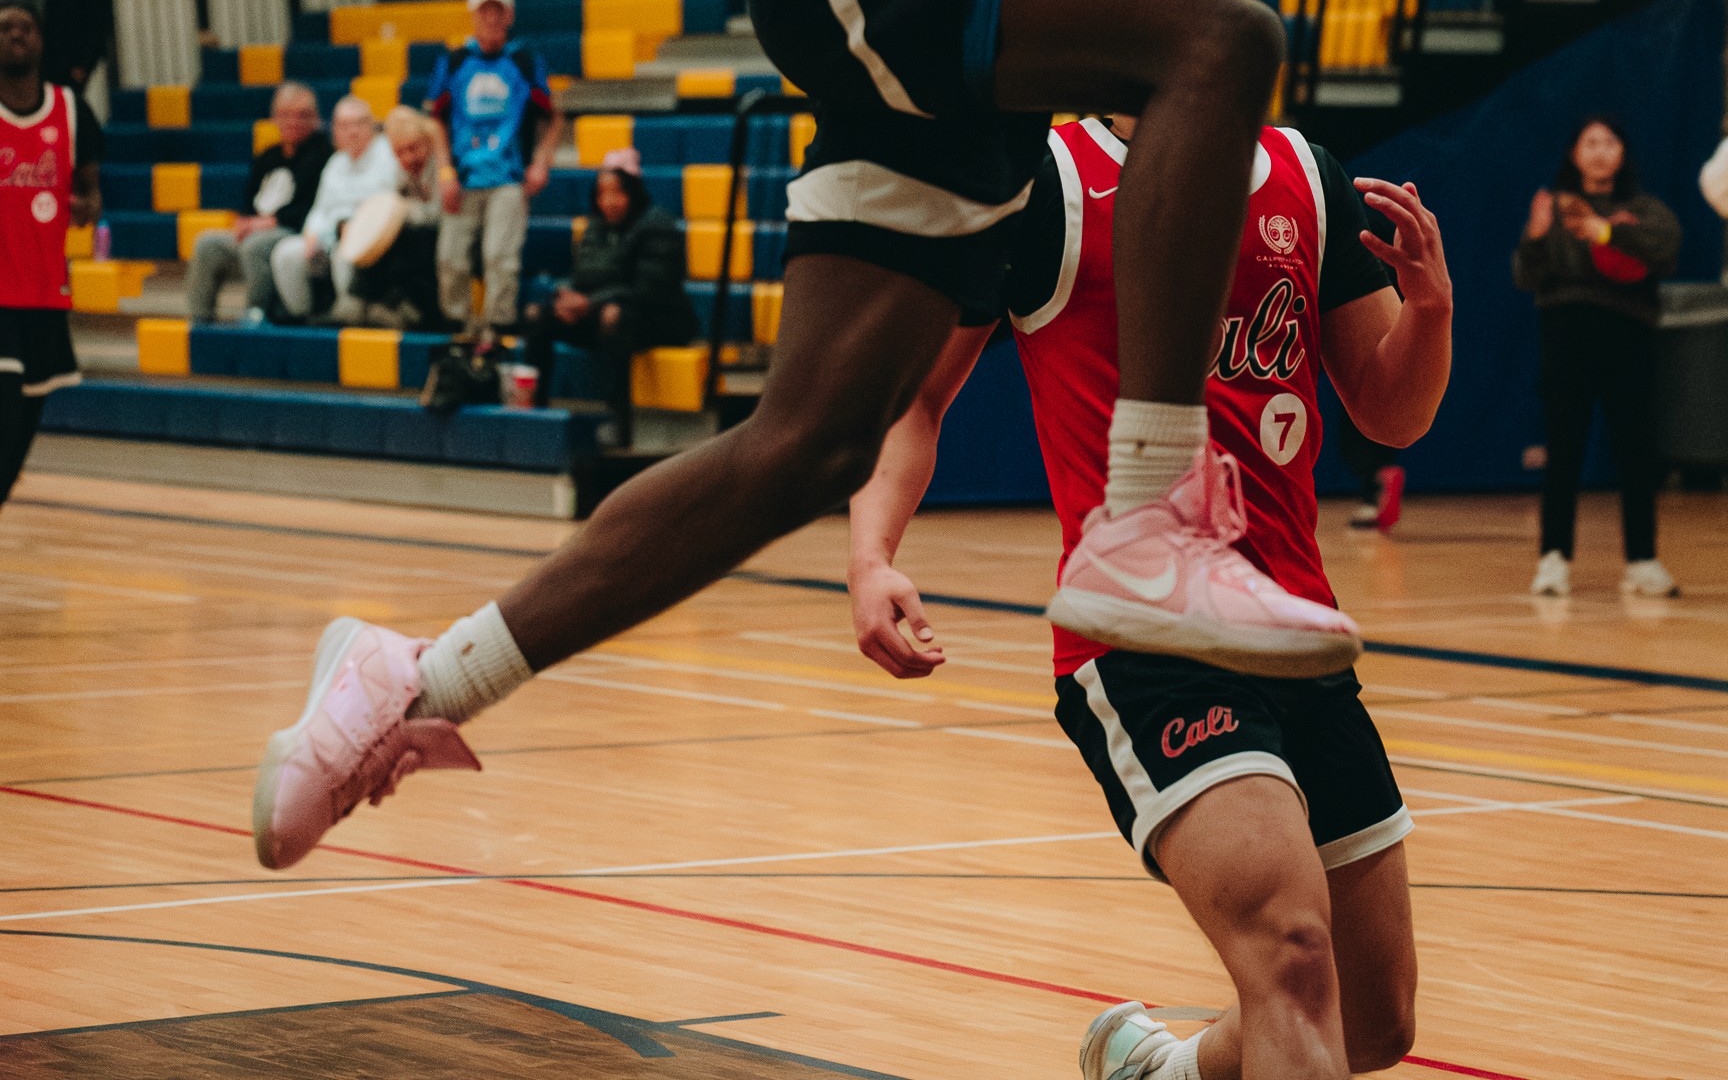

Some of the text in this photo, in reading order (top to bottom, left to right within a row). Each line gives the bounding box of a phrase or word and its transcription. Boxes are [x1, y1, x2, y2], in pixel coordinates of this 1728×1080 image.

[1207, 277, 1306, 381] ali
[1274, 412, 1297, 452] 7
[1161, 705, 1240, 758] Cali
